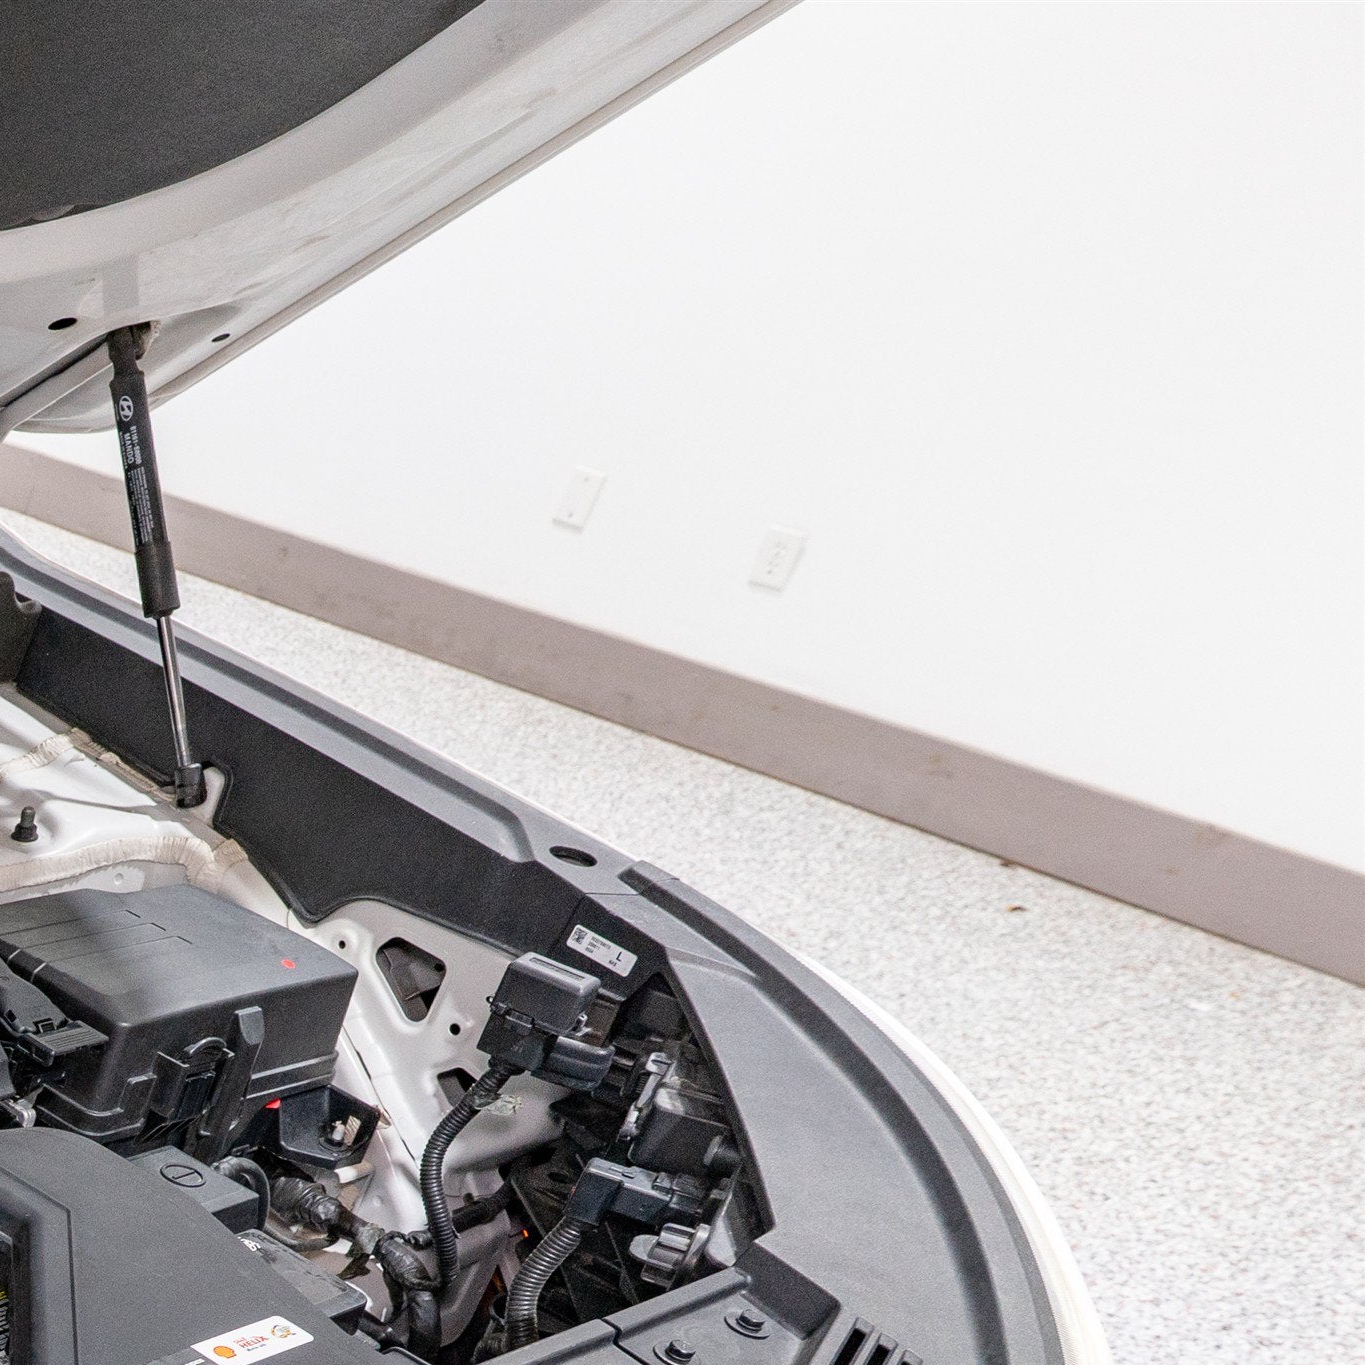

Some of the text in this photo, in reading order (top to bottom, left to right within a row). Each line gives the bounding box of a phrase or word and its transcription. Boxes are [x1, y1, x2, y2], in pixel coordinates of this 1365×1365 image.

[124, 433, 135, 465] MANDO
[615, 951, 623, 962] L
[240, 1334, 270, 1349] HELIX
